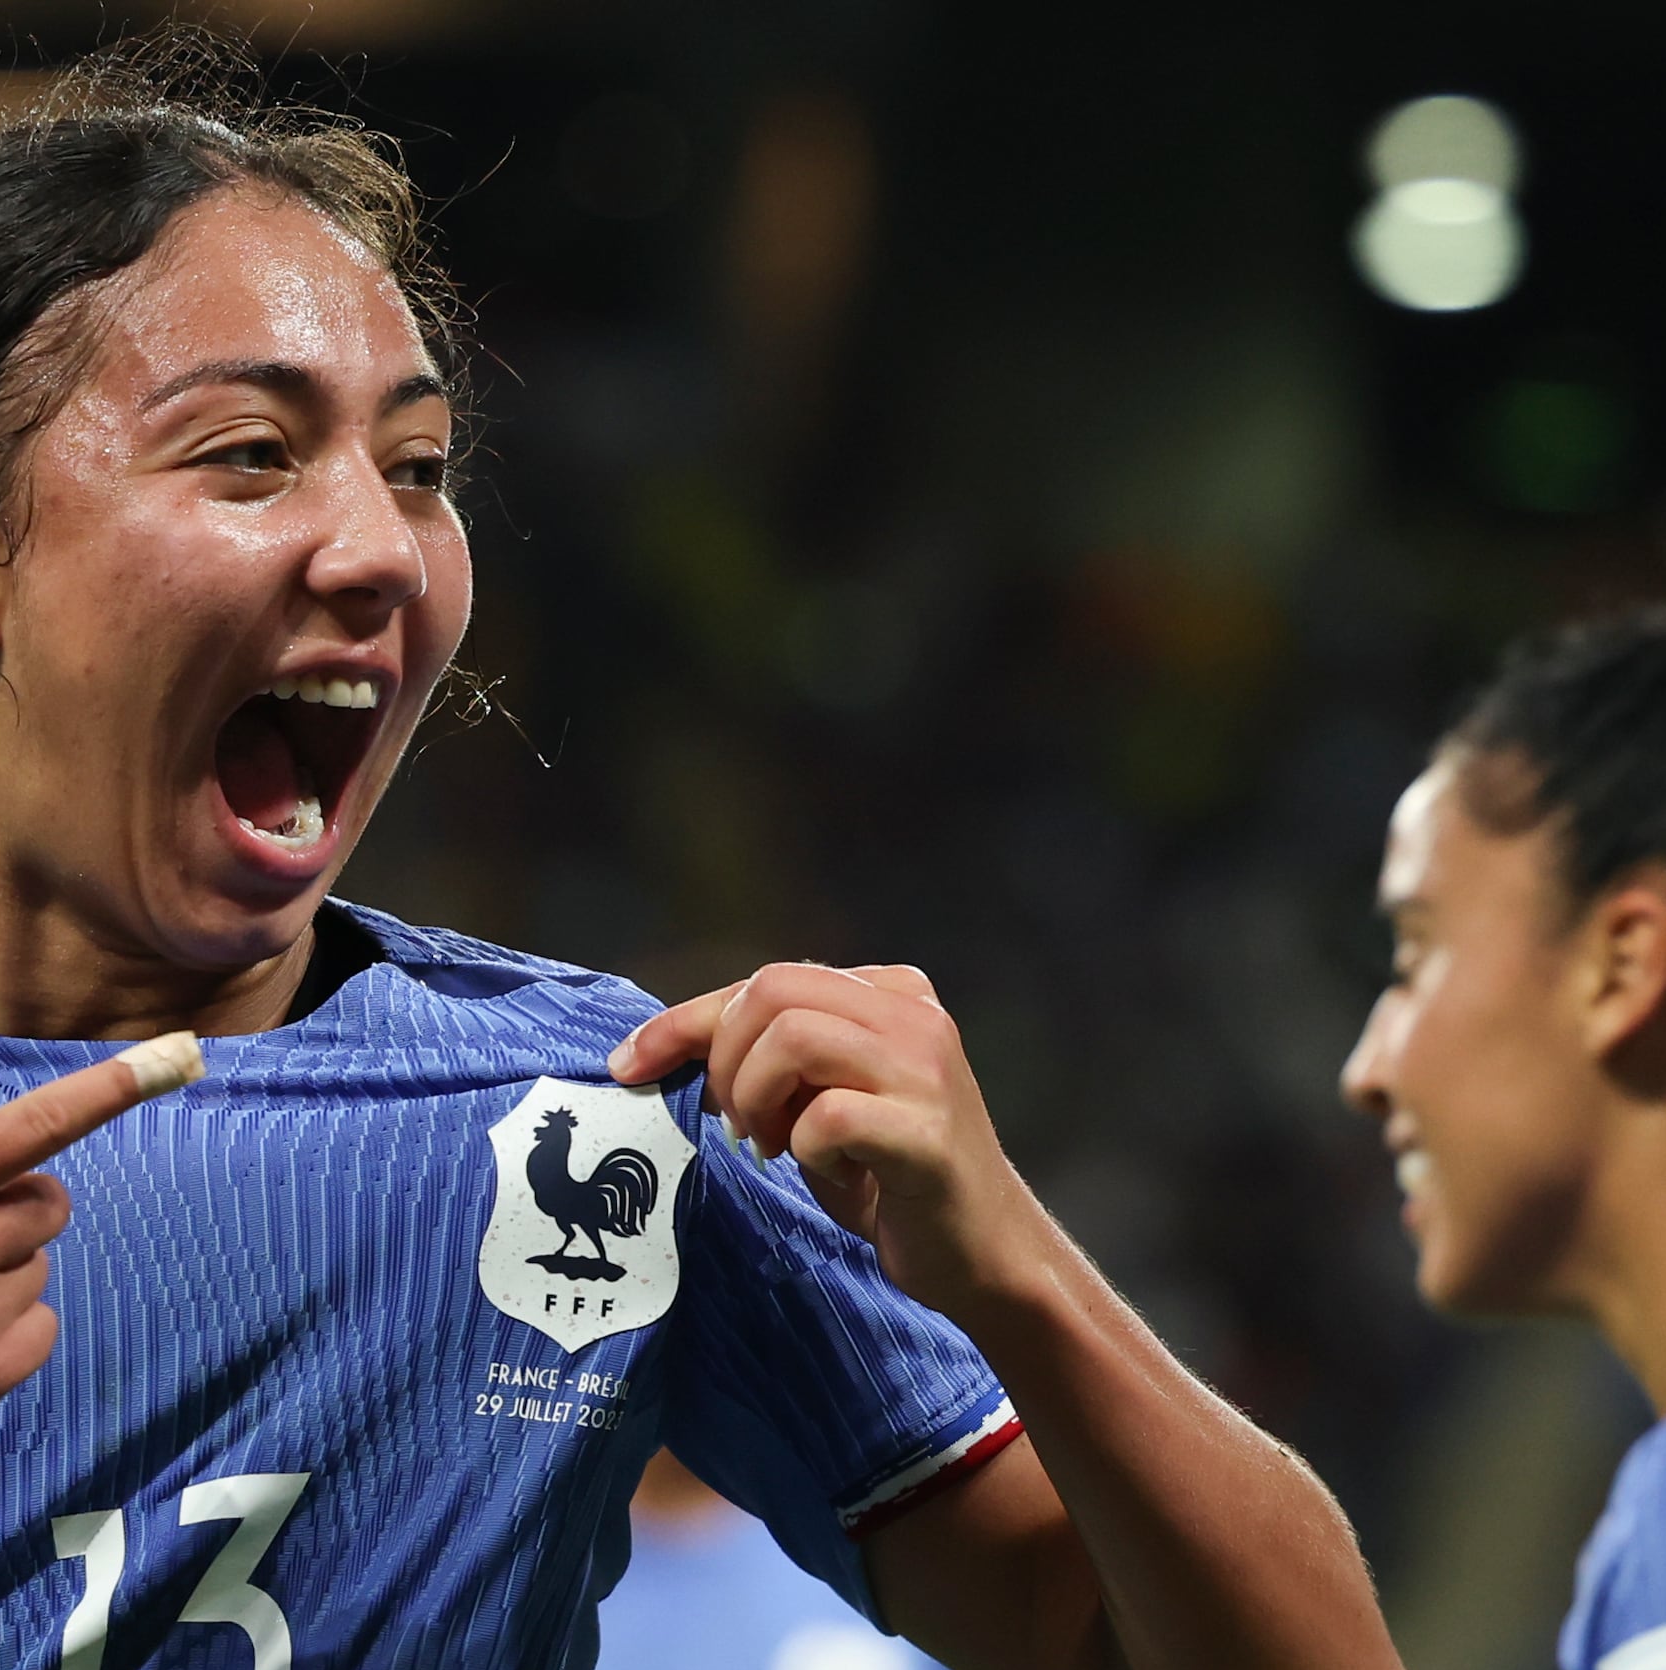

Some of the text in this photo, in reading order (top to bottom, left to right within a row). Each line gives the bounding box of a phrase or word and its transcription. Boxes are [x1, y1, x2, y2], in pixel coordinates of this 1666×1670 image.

[488, 1363, 560, 1391] FRANCE
[576, 1372, 630, 1401] BRÉSIL
[474, 1393, 625, 1431] 29 JUILLET 2023
